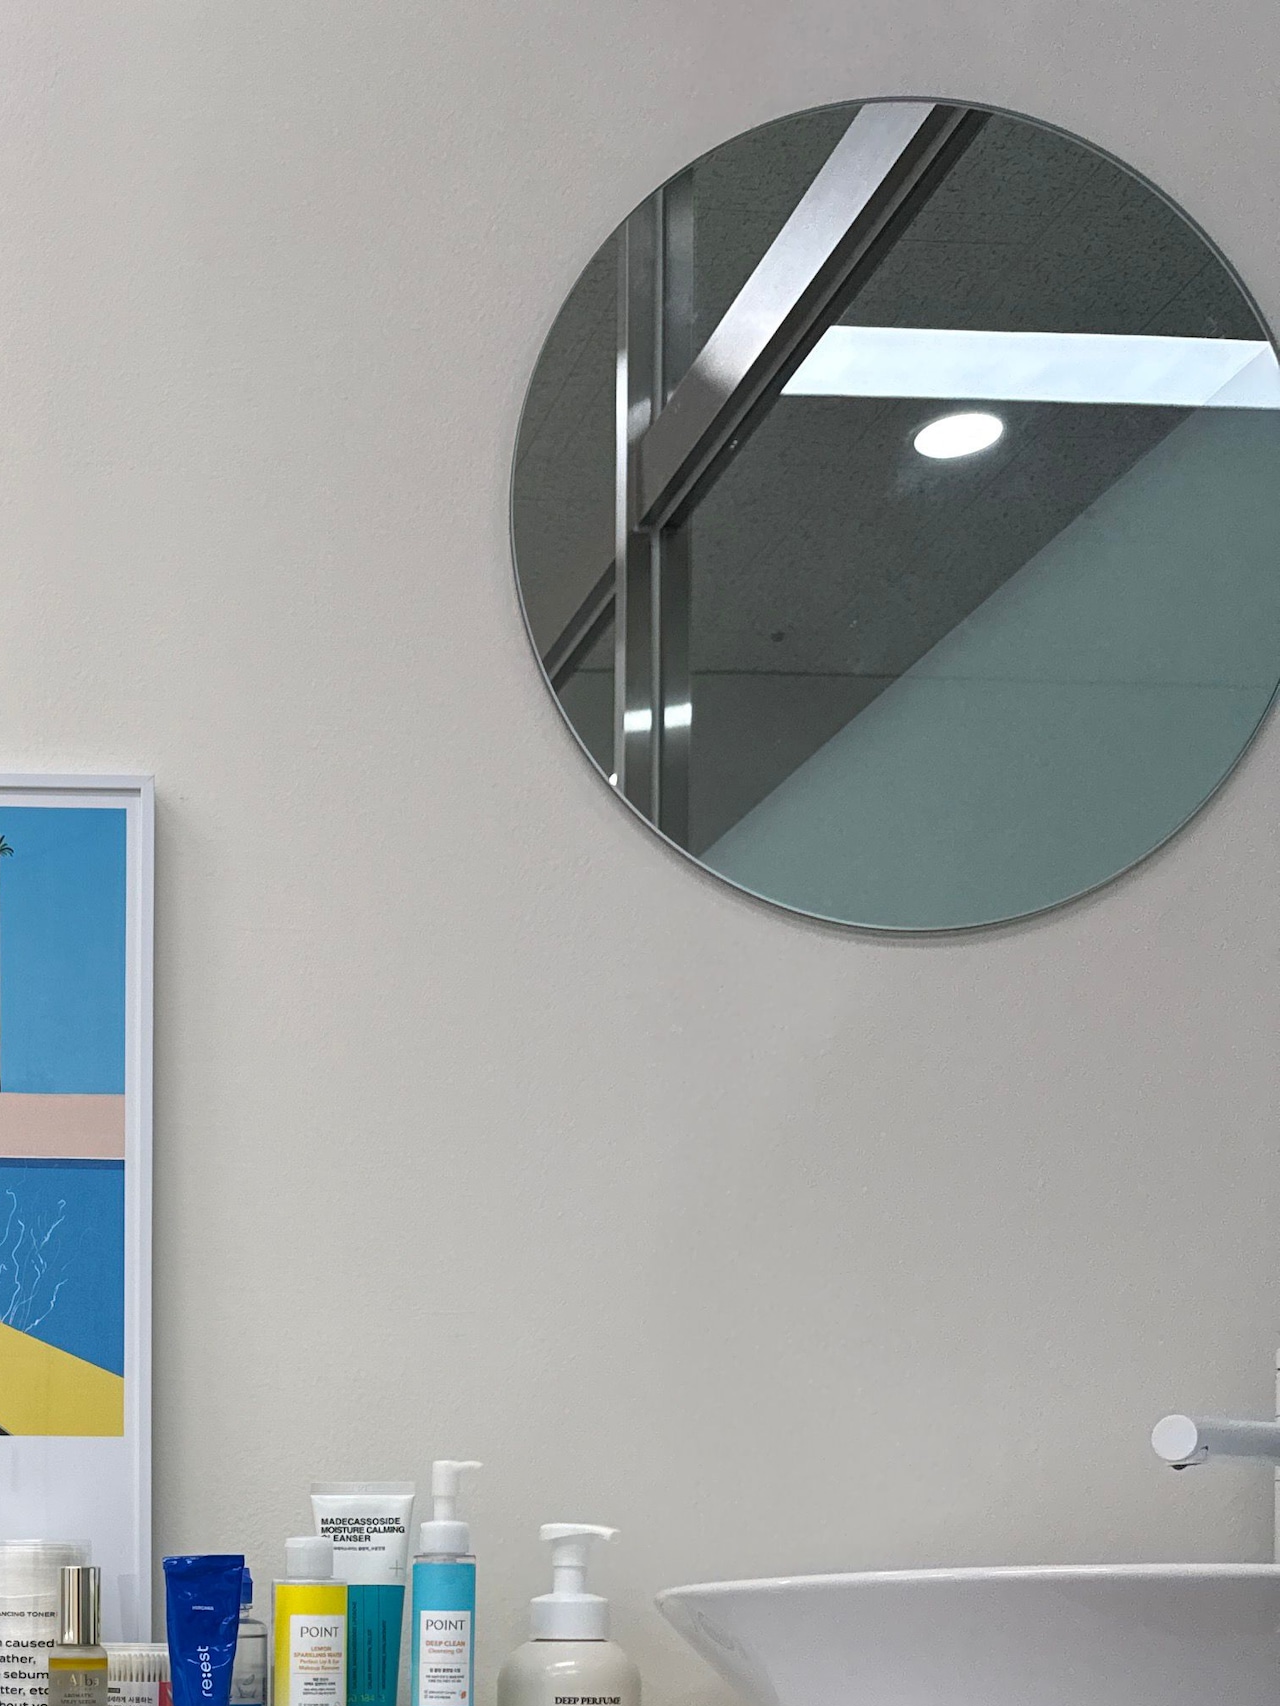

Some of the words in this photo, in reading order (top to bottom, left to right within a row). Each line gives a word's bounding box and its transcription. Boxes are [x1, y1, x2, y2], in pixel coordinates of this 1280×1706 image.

[321, 1517, 401, 1526] MADECASSOSIDE
[321, 1526, 365, 1534] MOISTURE
[366, 1526, 406, 1534] CALMING
[321, 1534, 371, 1542] EANSER
[425, 1619, 466, 1631] POINT
[300, 1626, 339, 1638] POINT
[5, 1638, 55, 1648] caused
[3, 1669, 49, 1680] sebum
[196, 1645, 213, 1698] re:est
[554, 1696, 580, 1705] DEEP
[581, 1696, 621, 1705] PERFUME
